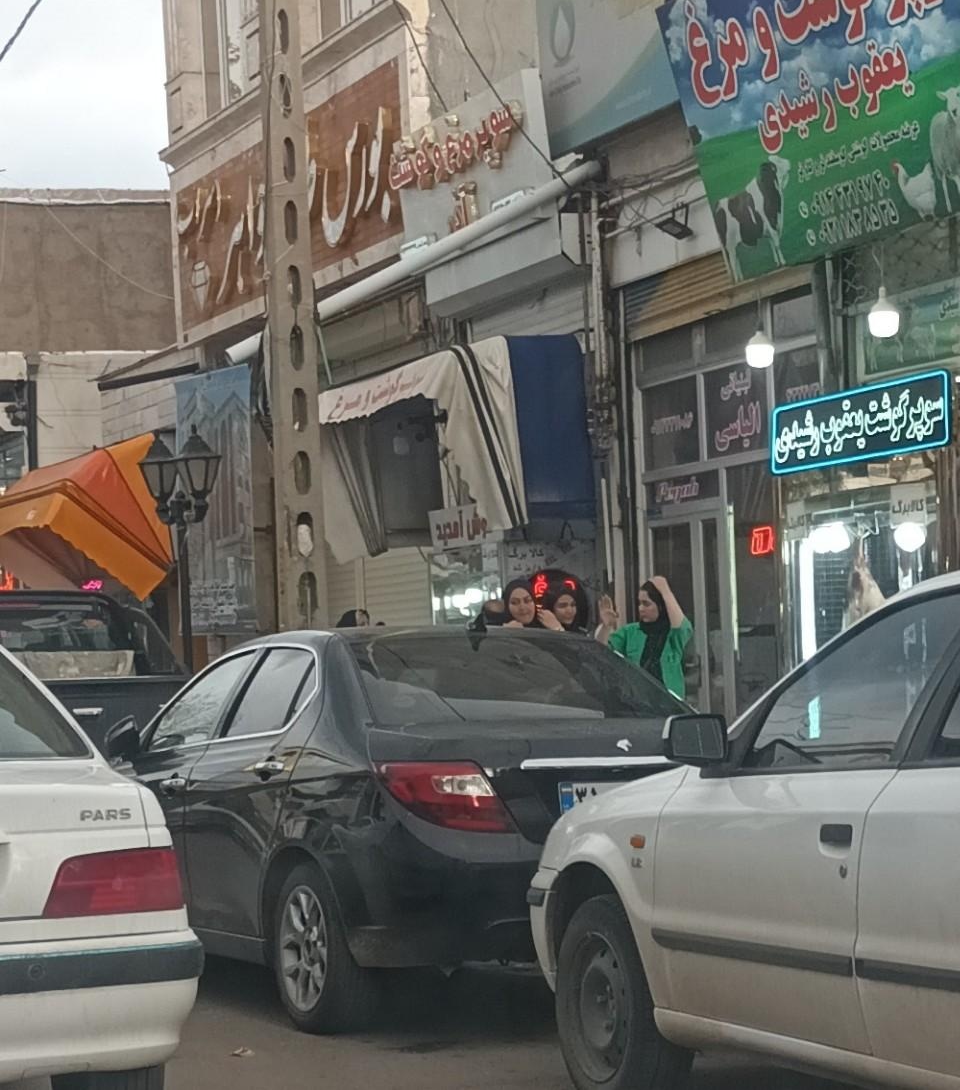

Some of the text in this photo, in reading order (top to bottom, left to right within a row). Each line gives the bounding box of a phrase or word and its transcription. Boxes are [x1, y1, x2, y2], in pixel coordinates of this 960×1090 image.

[686, 0, 749, 108] مرغ
[752, 7, 780, 80] و
[759, 40, 915, 154] یعقوب رشیدی
[714, 400, 762, 453] الیاسی
[864, 388, 911, 443] گوشت
[905, 395, 945, 443] سوپر
[465, 507, 488, 542] وش
[79, 807, 132, 822] PARS
